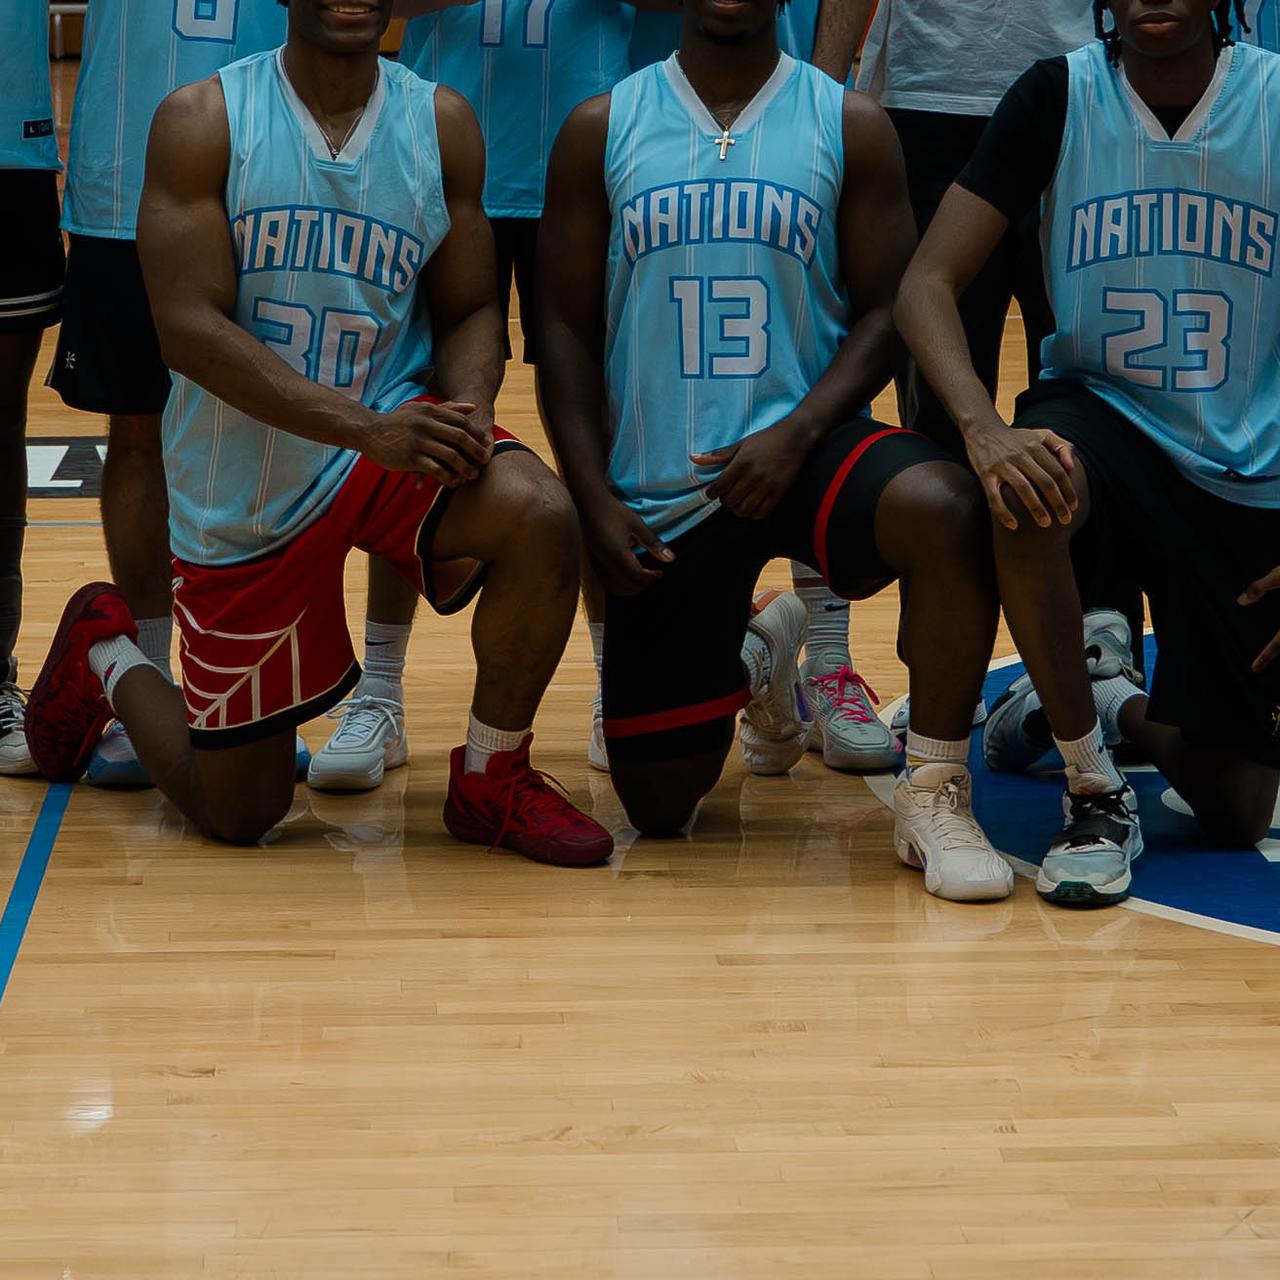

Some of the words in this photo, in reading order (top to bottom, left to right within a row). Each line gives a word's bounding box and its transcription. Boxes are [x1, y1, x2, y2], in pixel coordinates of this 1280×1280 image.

[233, 204, 425, 295] NATIONS
[622, 177, 824, 270] NATIONS
[1066, 187, 1279, 278] NATIONS
[669, 275, 771, 379] 13
[1101, 286, 1233, 393] 23
